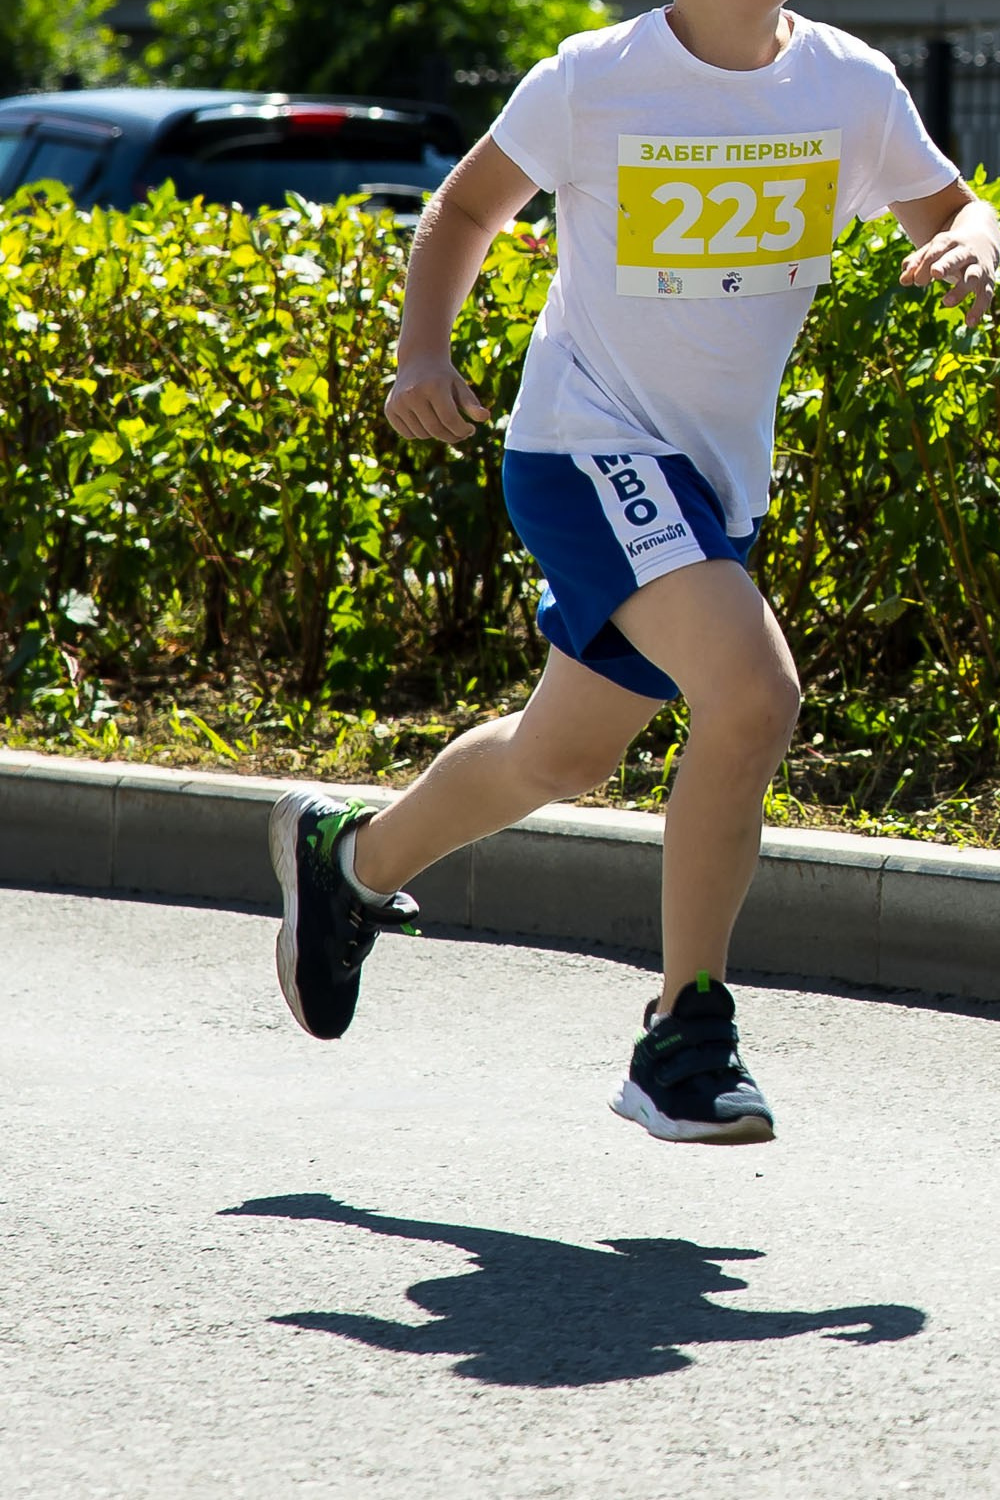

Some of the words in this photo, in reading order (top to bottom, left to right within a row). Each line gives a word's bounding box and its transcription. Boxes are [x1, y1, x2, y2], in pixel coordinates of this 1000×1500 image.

[640, 143, 719, 162] ЗАБЕГ
[726, 139, 823, 162] ПЕРВЫХ
[651, 178, 806, 255] 223
